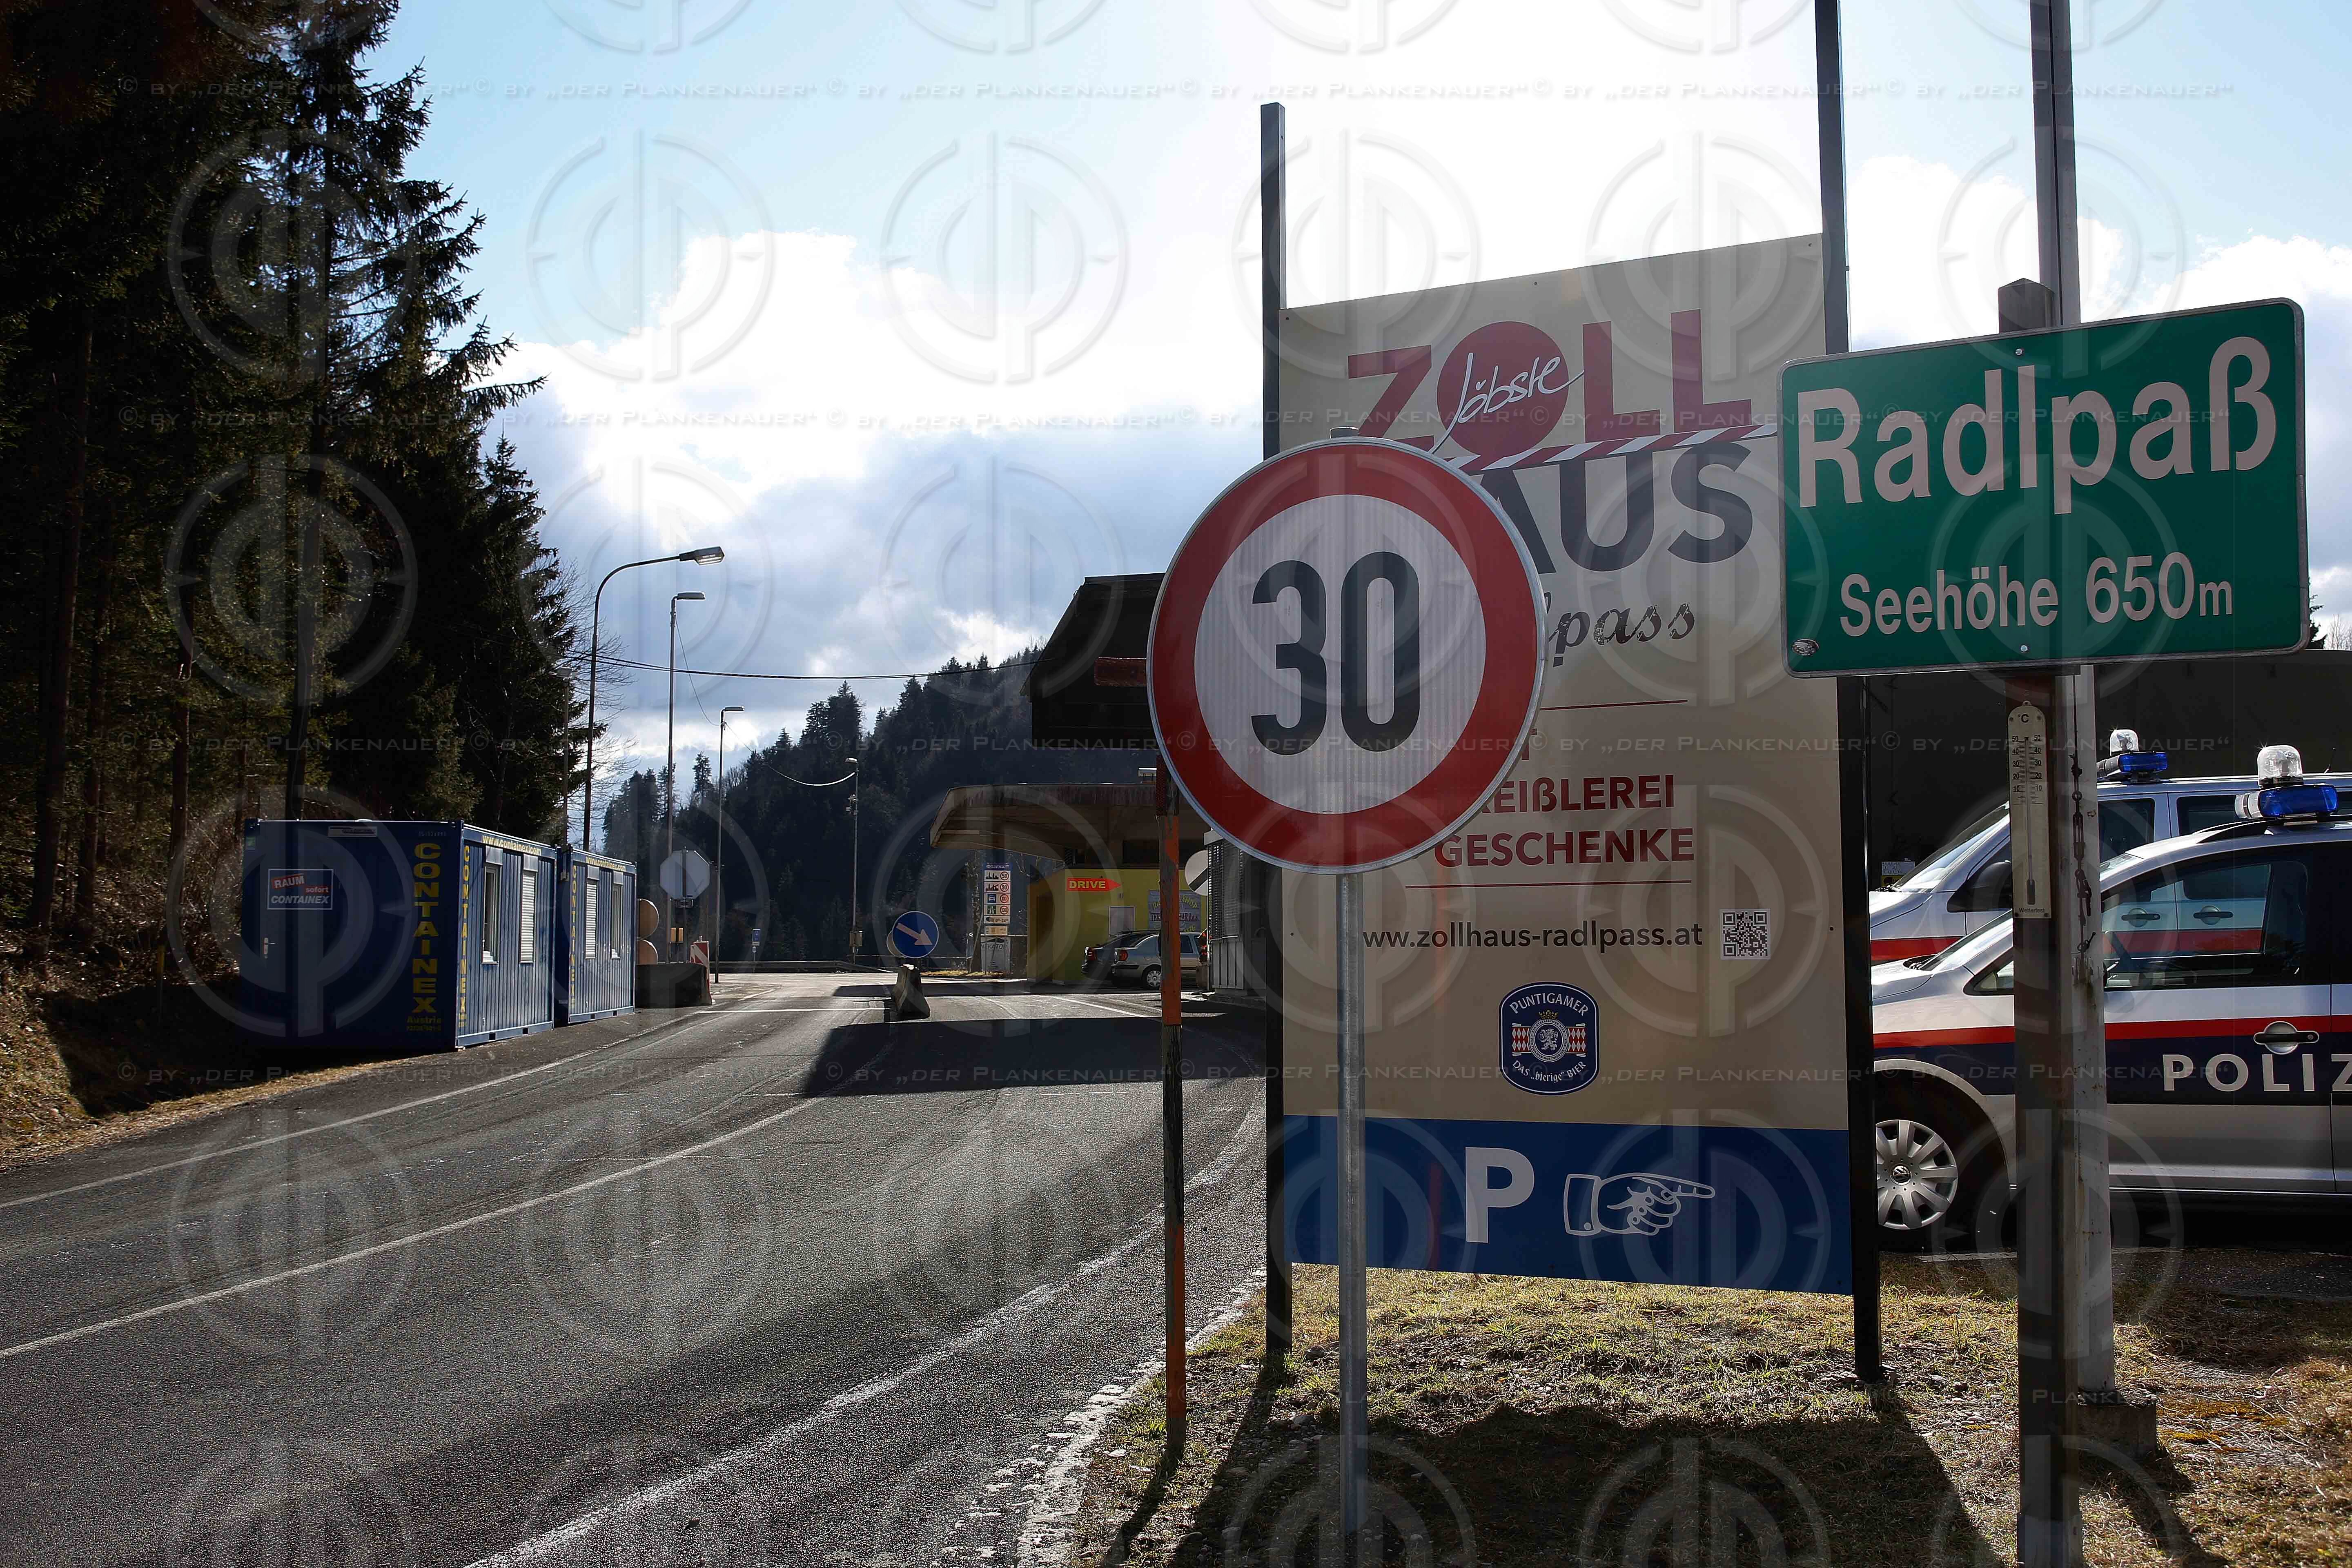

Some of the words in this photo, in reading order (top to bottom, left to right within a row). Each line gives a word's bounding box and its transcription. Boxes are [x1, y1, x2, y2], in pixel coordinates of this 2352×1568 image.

[1348, 309, 1752, 458] ZOLL
[1798, 336, 2277, 514] Radlpaß
[1475, 442, 1753, 574] AUS
[1840, 566, 2058, 637] Seehöhe
[1252, 552, 1420, 755] 30
[1481, 774, 1675, 813] EIßLEREI
[482, 835, 542, 856] www.containex.com
[1434, 827, 1695, 867] GESCHENKE
[271, 895, 330, 904] CONTAINEX
[274, 875, 305, 889] RAUM
[1069, 880, 1107, 889] DRIVE
[412, 843, 441, 1013] CONTAINEX
[460, 845, 470, 1013] CONTAINEX
[1363, 921, 1702, 954] ww.zollhaus-radlpass.at
[1509, 993, 1588, 1016] PUNTIGAMER
[1512, 1060, 1530, 1076] DAS
[1567, 1060, 1587, 1078] BIER
[1465, 1147, 1535, 1244] P
